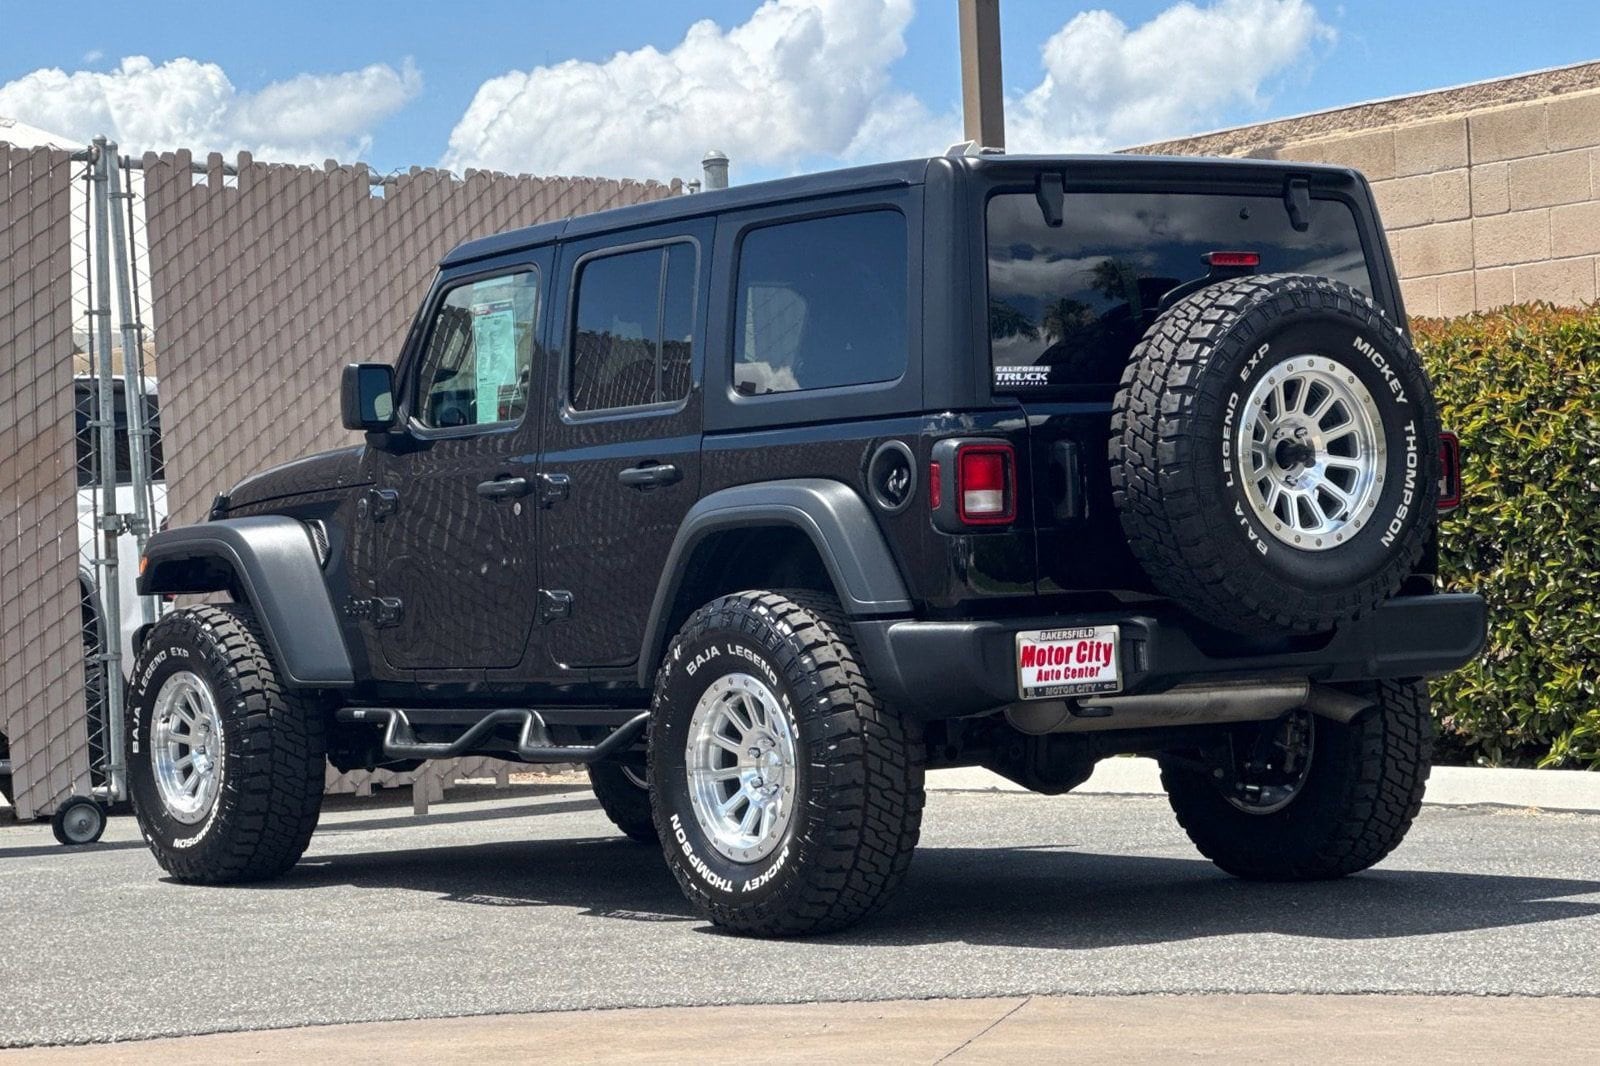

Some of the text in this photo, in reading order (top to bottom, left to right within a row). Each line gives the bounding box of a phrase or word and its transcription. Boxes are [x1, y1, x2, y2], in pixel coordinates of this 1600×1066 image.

[1222, 343, 1270, 556] BAJA LEGEND EXP
[1353, 336, 1418, 548] MICKEY THOMPSON
[1021, 641, 1113, 668] Motor City
[1036, 666, 1100, 682] Auto Center
[1041, 628, 1094, 640] BAKERSFIELD
[132, 707, 141, 754] BAJA
[139, 650, 167, 696] LEGEND
[686, 643, 800, 739] BAJA LEGEND EXP
[1045, 685, 1075, 696] MOTOR
[1076, 683, 1096, 693] CITY
[670, 813, 790, 893] MICKEY THOMPSON
